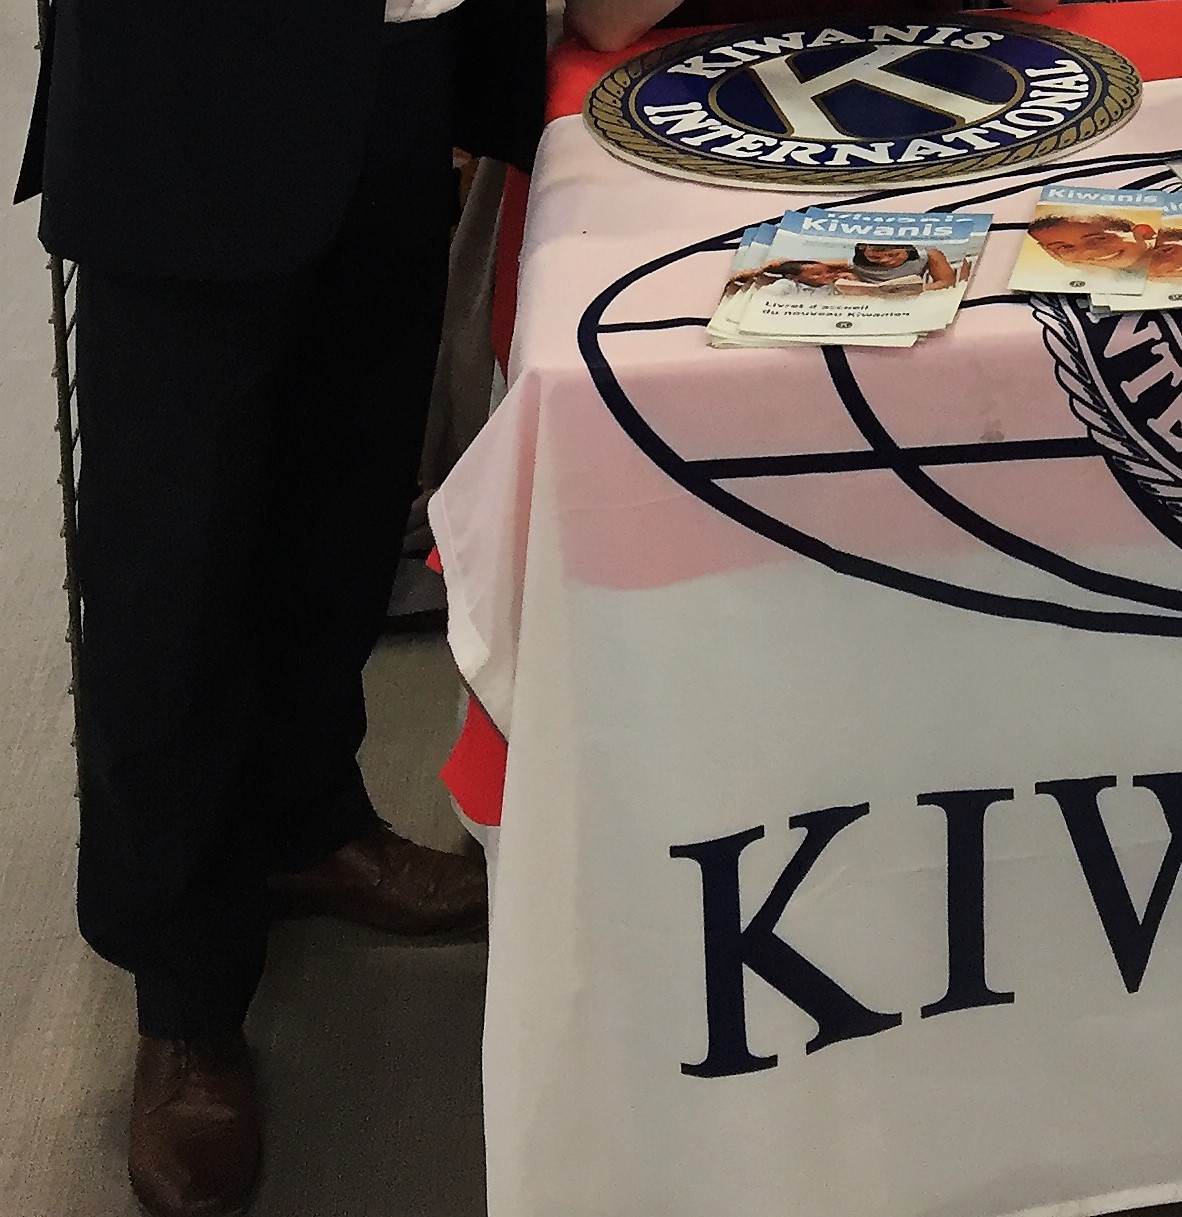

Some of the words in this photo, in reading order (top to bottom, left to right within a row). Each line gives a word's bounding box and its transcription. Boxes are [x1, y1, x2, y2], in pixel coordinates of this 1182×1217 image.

[667, 24, 1005, 81] KIWANIS
[642, 58, 1091, 167] INTERNATIONAL
[1048, 188, 1158, 204] Kiwanis
[801, 216, 953, 238] Kiwanis
